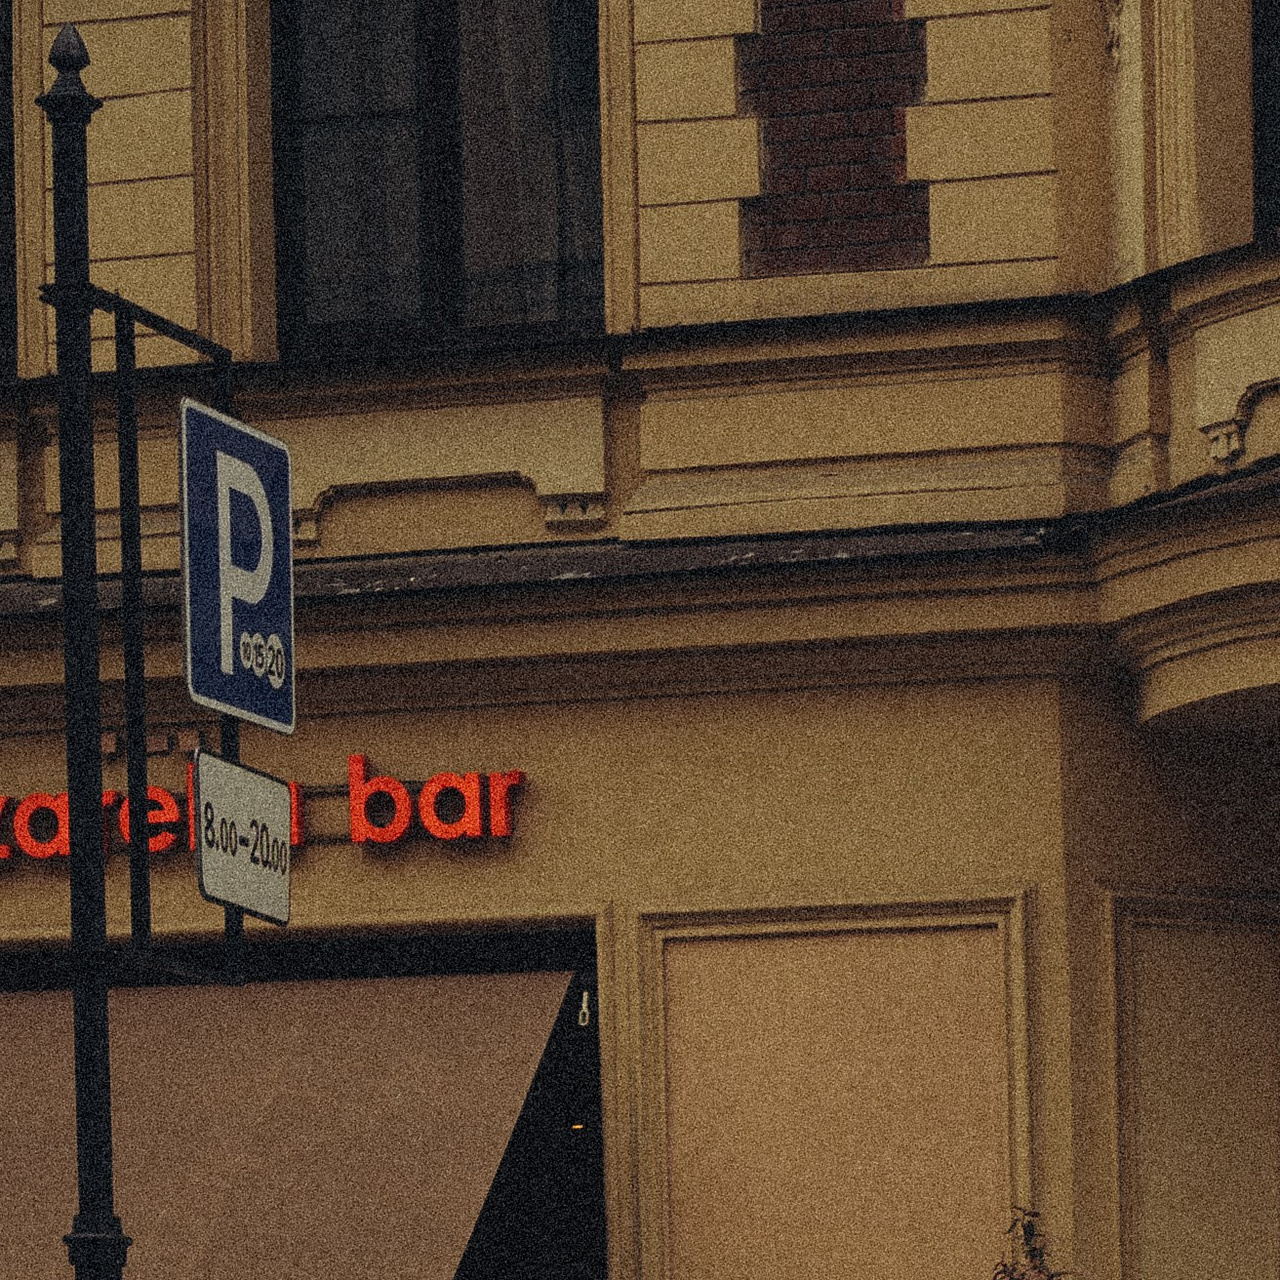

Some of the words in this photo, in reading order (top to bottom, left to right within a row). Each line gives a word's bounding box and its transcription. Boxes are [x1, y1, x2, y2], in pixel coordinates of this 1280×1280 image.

[216, 450, 274, 676] P
[266, 645, 284, 680] 20
[348, 753, 525, 843] bar
